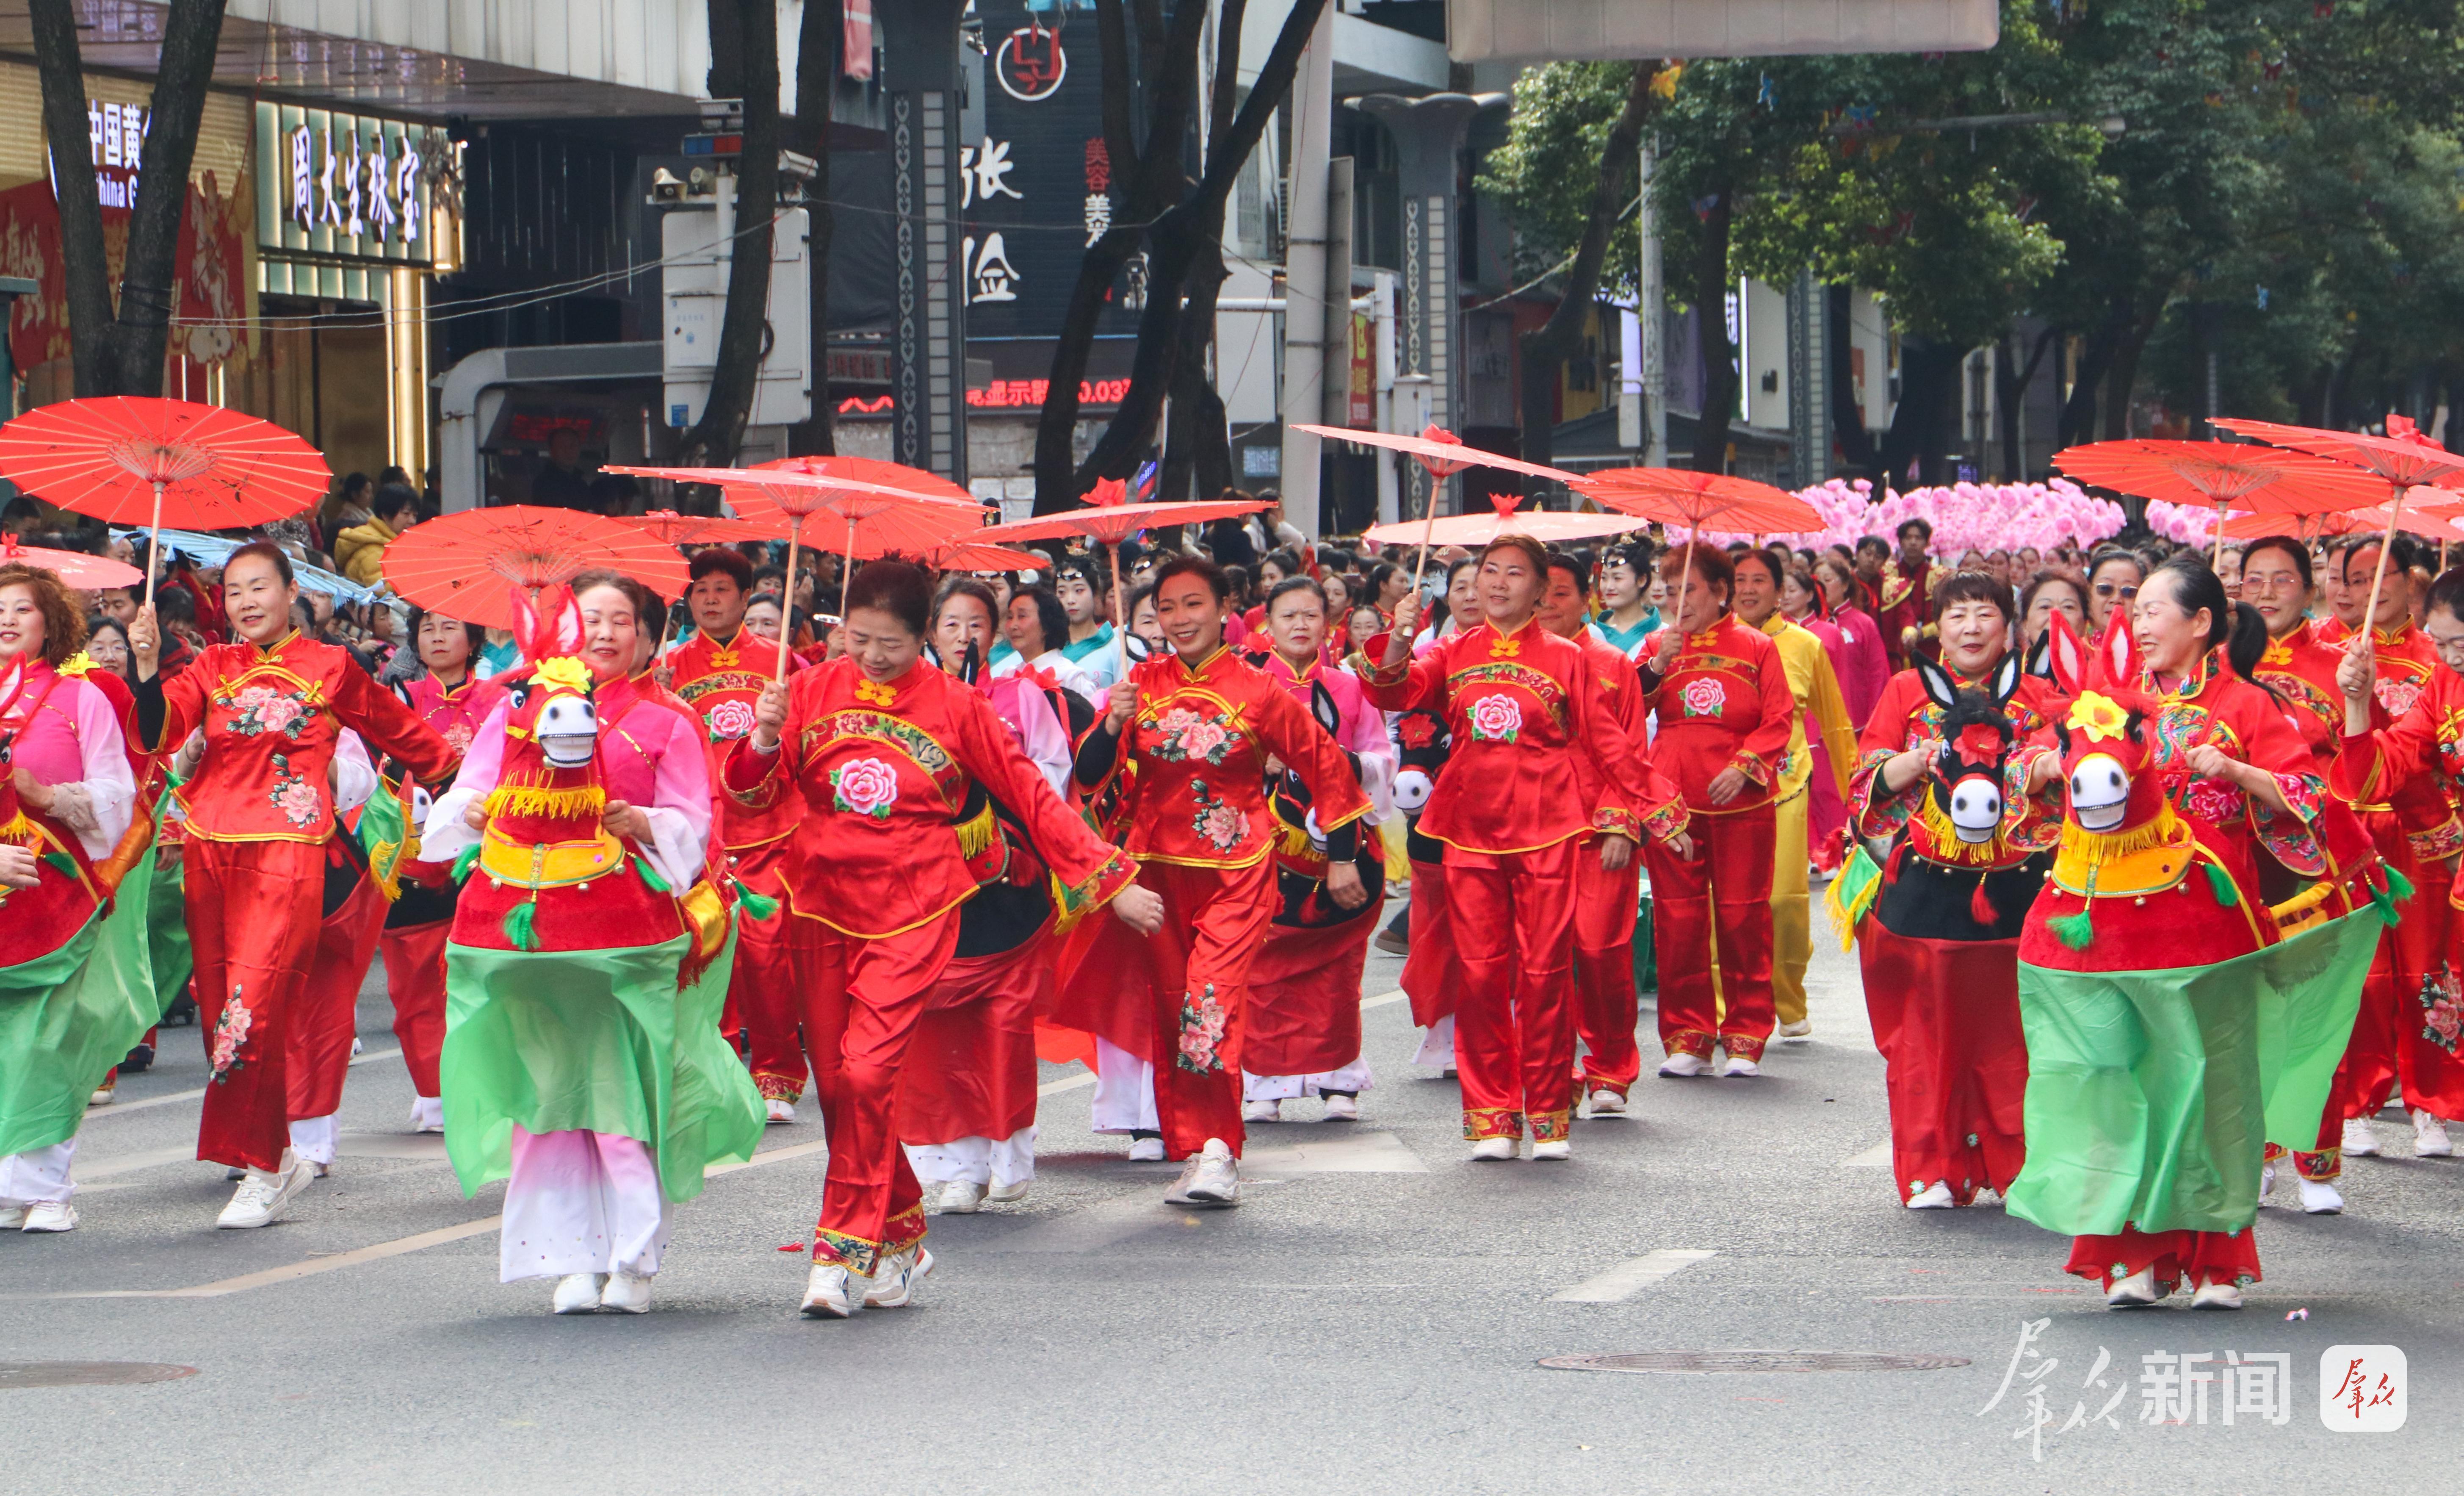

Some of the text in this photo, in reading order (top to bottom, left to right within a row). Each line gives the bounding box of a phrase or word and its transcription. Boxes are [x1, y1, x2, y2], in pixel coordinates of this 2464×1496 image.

[88, 98, 152, 171] 中国黄
[96, 171, 126, 208] hina
[292, 125, 421, 243] 周大生珠宝
